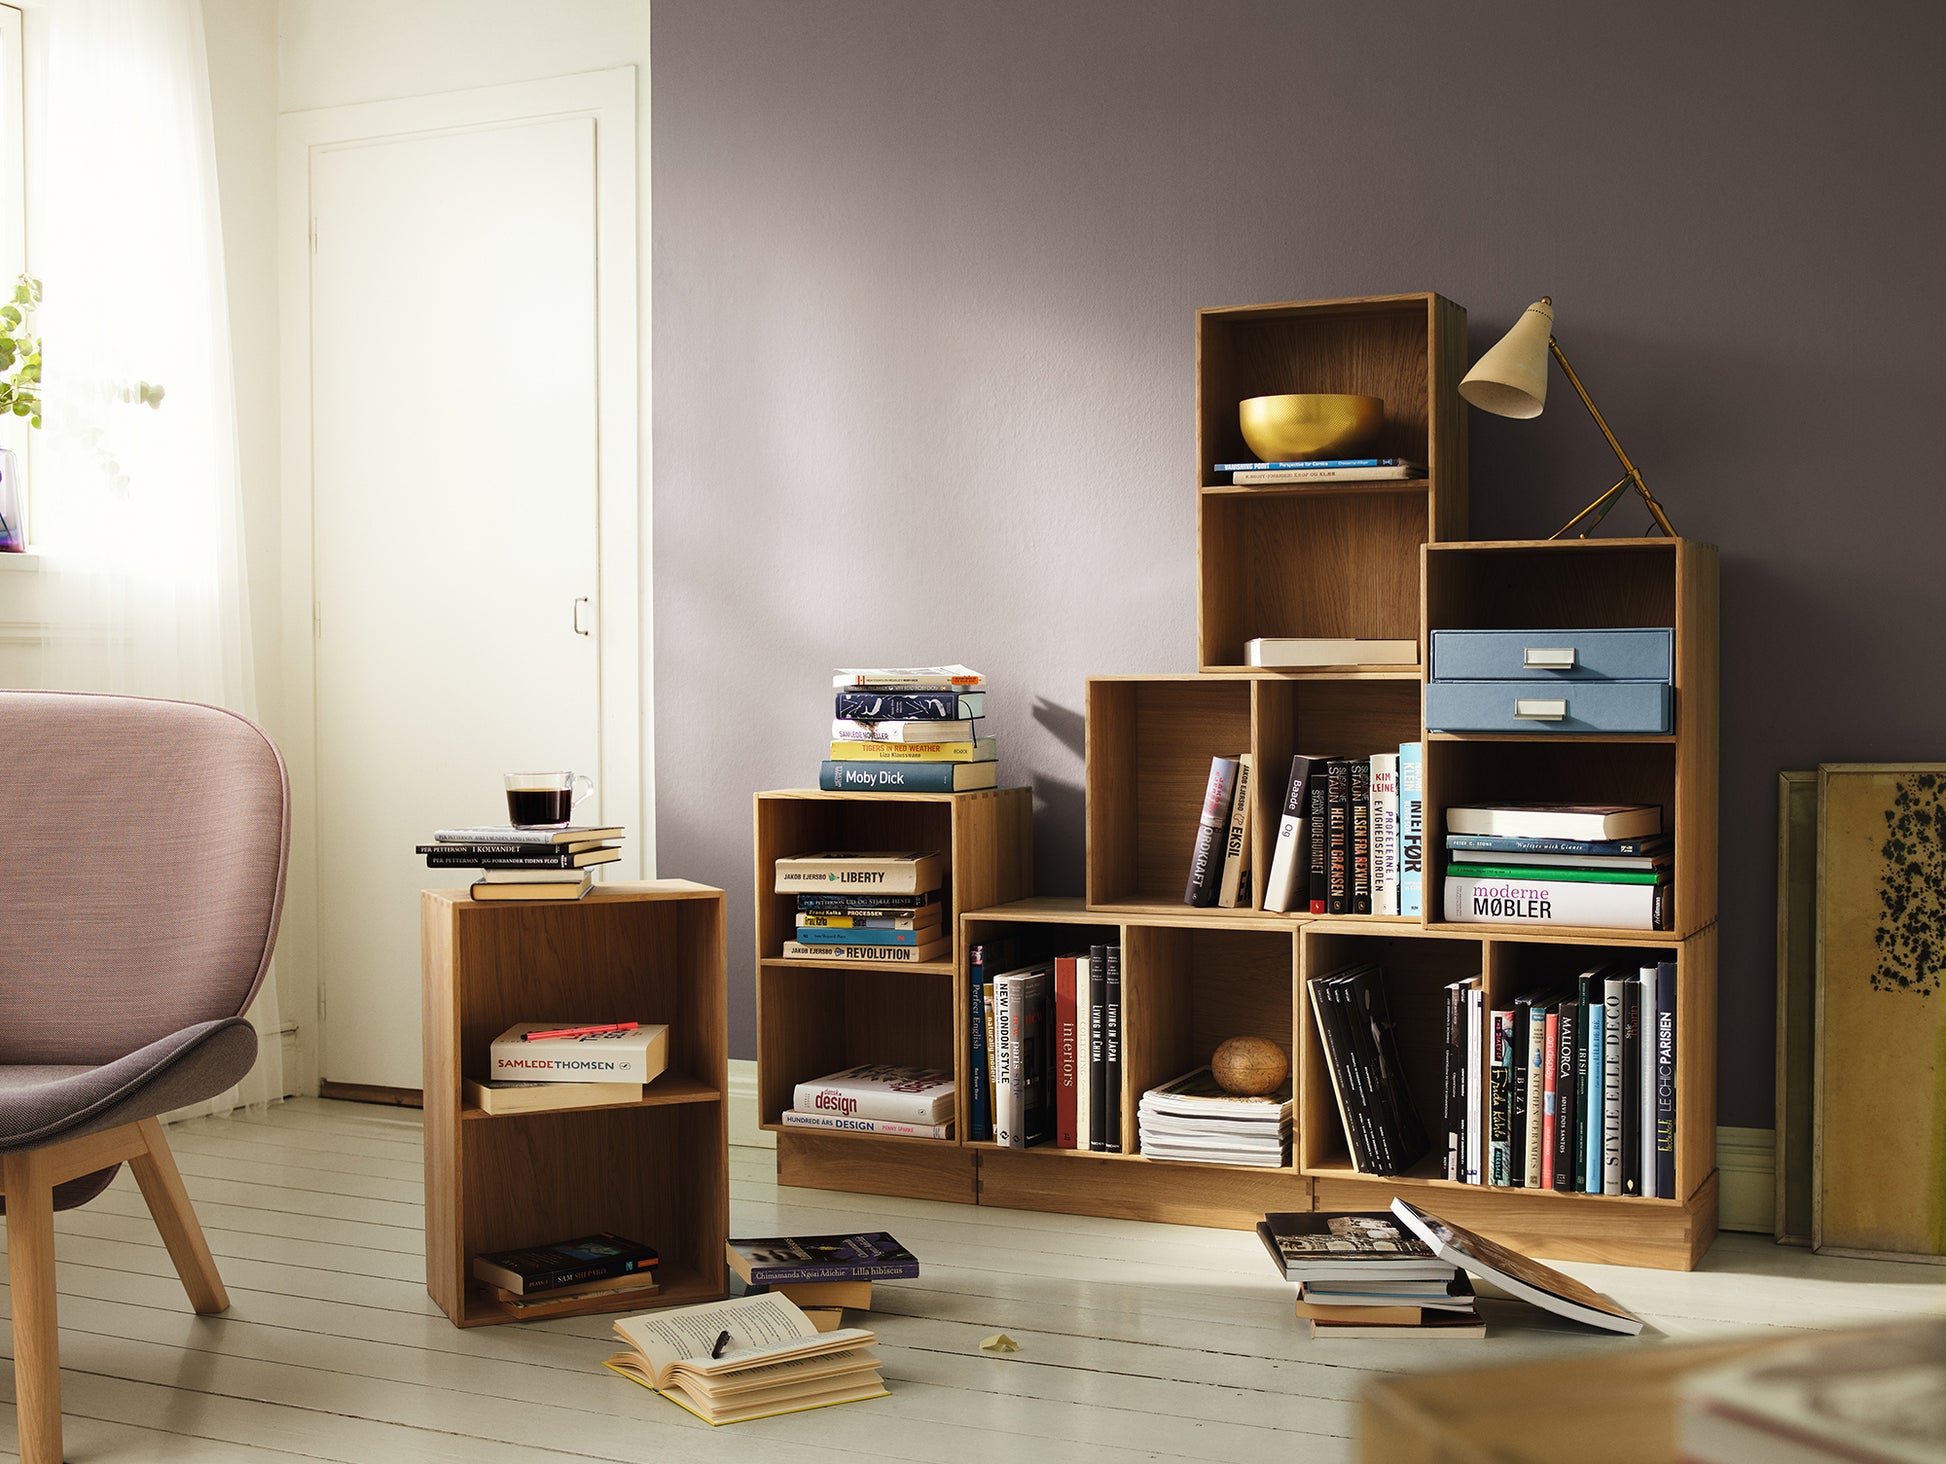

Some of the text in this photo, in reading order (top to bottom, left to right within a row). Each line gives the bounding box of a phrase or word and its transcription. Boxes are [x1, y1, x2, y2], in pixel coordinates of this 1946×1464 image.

[846, 771, 876, 786] Moby
[880, 771, 904, 784] Dick
[1328, 767, 1339, 803] STAUN
[1338, 767, 1346, 802] SUSANNE
[1352, 765, 1361, 801] STAUN
[1372, 784, 1394, 792] LEINE
[1404, 762, 1415, 791] KLEIN
[1238, 784, 1246, 811] EJERSBO
[1282, 780, 1302, 837] Baade Og
[1228, 827, 1243, 858] EKSIL
[1312, 817, 1323, 874] DØDERUMMET
[1330, 808, 1344, 896] HELT TIL GRÆNSEN
[1354, 806, 1368, 896] HILSEN FRA REXVILLE
[1375, 801, 1383, 892] EVIGHEDSFJORDEN
[1385, 811, 1393, 873] PROFETERNE
[1404, 836, 1421, 872] FØR
[841, 872, 885, 883] LIBERTY
[1473, 885, 1549, 900] moderne
[1474, 898, 1552, 919] MØBLER
[847, 948, 910, 960] REVOLUTION
[972, 984, 980, 1049] Perfect English
[1092, 1005, 1103, 1062] LIVING IN CHINA
[1108, 1004, 1118, 1027] LIVING
[1629, 1005, 1638, 1037] marin
[987, 1017, 997, 1083] naturally modern
[1000, 984, 1009, 1084] NEW LONDON STYLE
[1079, 1021, 1087, 1075] COLLECTING
[1108, 1039, 1118, 1062] JAPAN
[1560, 1017, 1571, 1078] MALLORCA
[1011, 1041, 1023, 1069] paris
[1063, 1023, 1075, 1087] interiors
[1545, 1036, 1555, 1080] on display
[1579, 1048, 1587, 1075] IRISH
[1660, 1012, 1672, 1112] LE CHIC PARISIEN
[1011, 1073, 1023, 1098] style
[1516, 1066, 1526, 1115] IBIZA
[1606, 996, 1620, 1166] STYLE ELLE DECO
[816, 1092, 857, 1115] design
[1491, 1069, 1509, 1138] Frida Kahlo
[1530, 1073, 1540, 1169] KITCHEN CERAMICS
[787, 1117, 820, 1125] HUNDREDE
[836, 1120, 874, 1131] DESIGN
[1657, 1119, 1669, 1151] ELLE
[557, 1274, 573, 1283] SAM
[574, 1268, 606, 1280] SHEPARD
[801, 1270, 819, 1279] Ngozi
